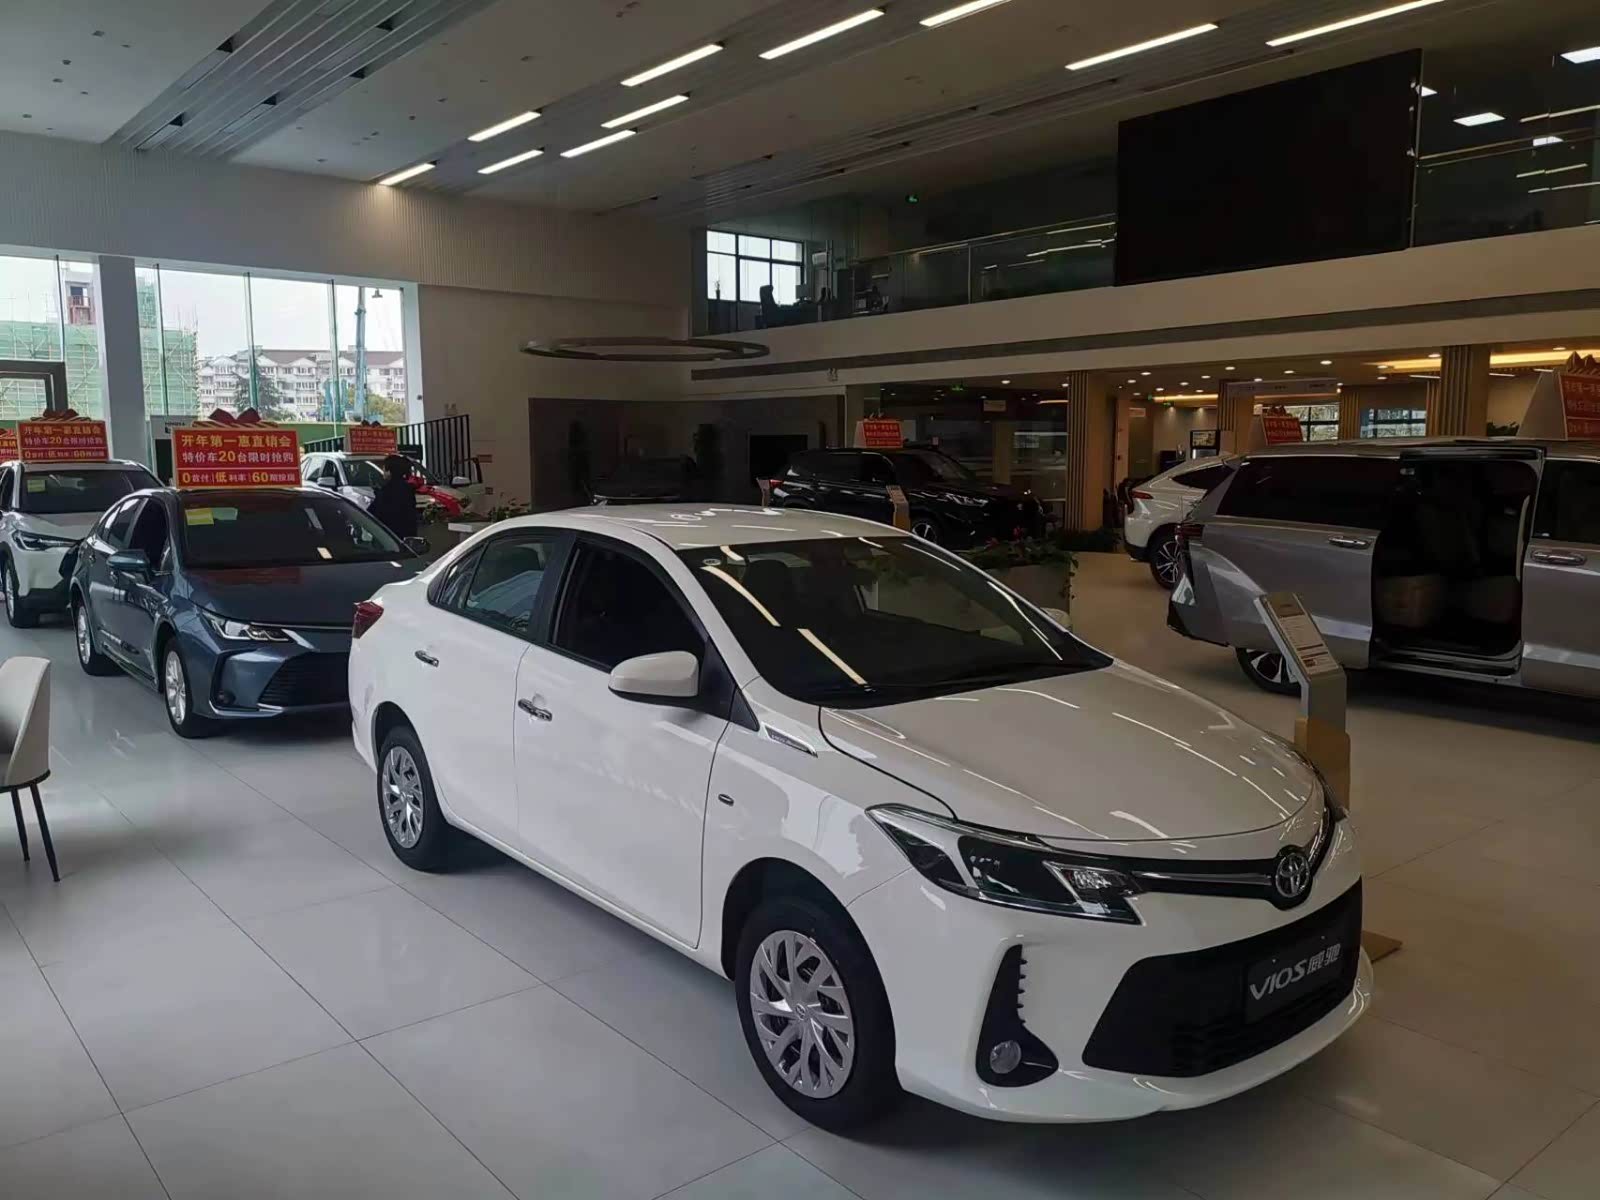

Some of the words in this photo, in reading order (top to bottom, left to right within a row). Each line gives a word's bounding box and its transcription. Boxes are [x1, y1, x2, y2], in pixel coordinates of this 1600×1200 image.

[181, 434, 292, 448] 开年第一惠直销会
[182, 449, 294, 463] 特价车20台限时抢购
